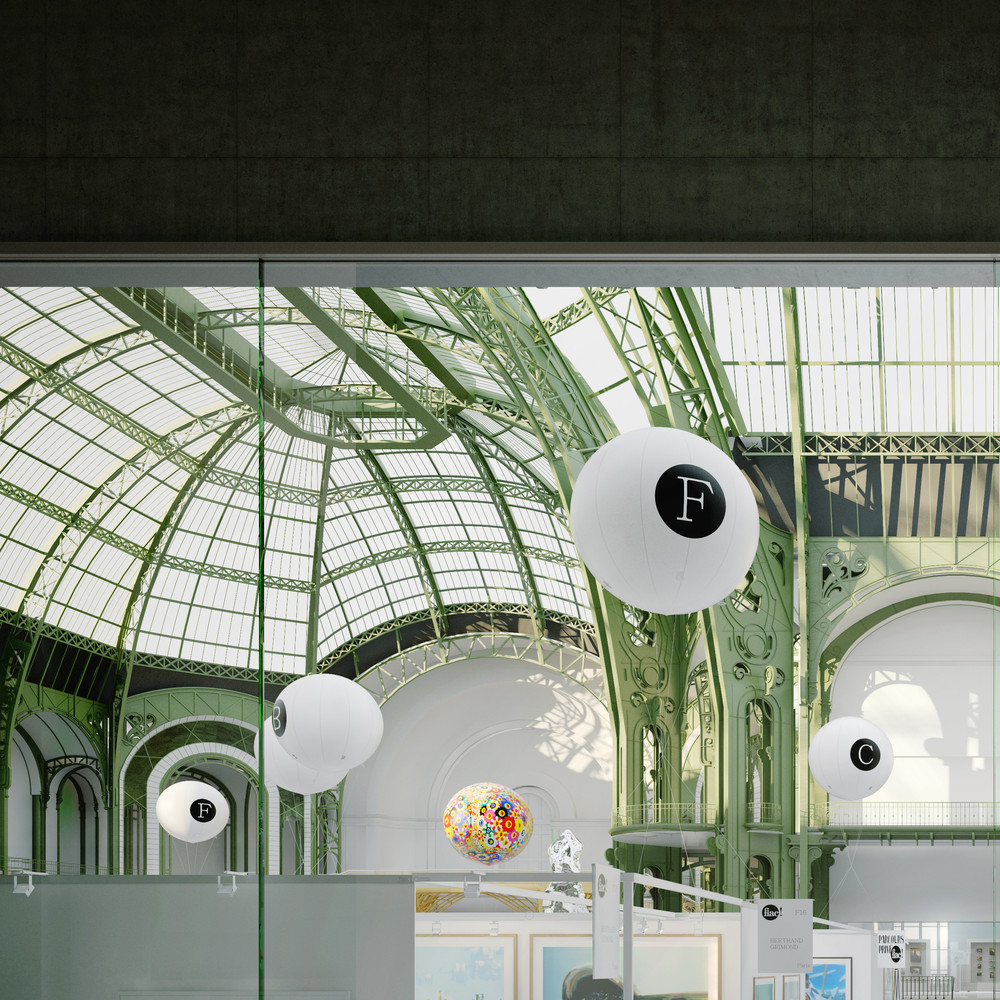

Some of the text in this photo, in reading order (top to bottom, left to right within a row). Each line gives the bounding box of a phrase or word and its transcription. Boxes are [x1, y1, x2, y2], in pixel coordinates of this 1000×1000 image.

[677, 475, 714, 523] F
[272, 705, 281, 731] B
[857, 743, 874, 766] C
[197, 802, 213, 819] F
